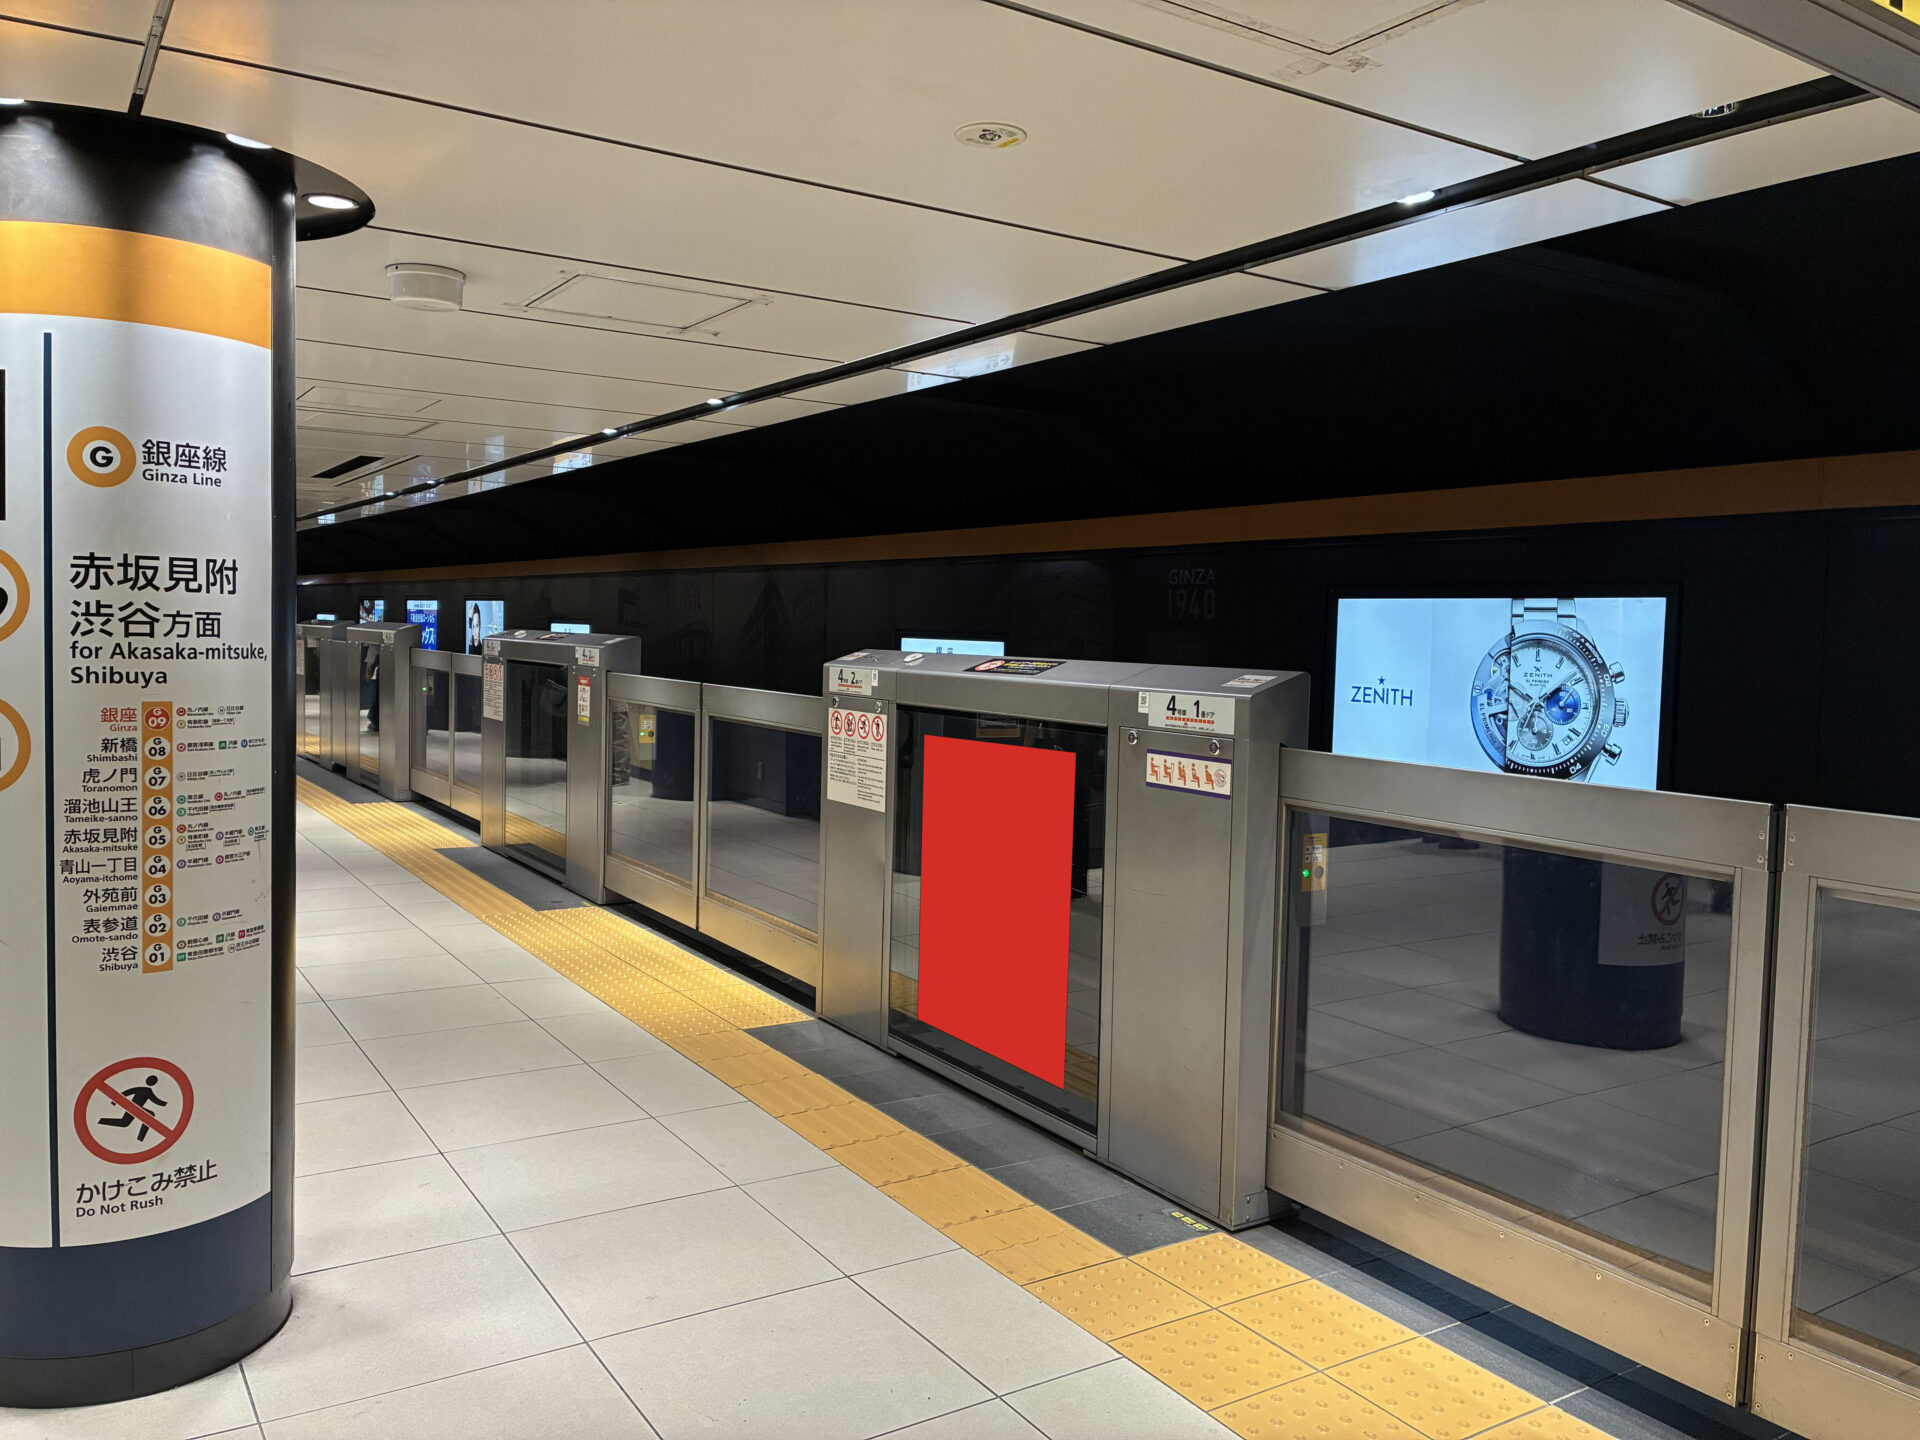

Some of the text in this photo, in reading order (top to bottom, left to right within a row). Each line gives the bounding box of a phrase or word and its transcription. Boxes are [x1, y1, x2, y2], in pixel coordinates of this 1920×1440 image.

[89, 446, 114, 468] G
[142, 438, 227, 473] 銀座線
[142, 469, 222, 487] Ginza Line
[69, 552, 238, 595] 赤坂見附
[1168, 568, 1216, 584] GINZA
[1168, 588, 1216, 620] 1940
[70, 600, 222, 638] 渋谷方面
[70, 641, 268, 662] for Akasaka-mitsuke,
[71, 666, 167, 688] Shibuya
[1351, 686, 1413, 706] ZENITH
[100, 707, 138, 723] 銀座
[148, 717, 166, 727] 09
[109, 724, 137, 732] Ginza
[101, 737, 138, 753] 新橋
[148, 747, 166, 757] 08
[87, 754, 138, 762] Shimbashi
[82, 768, 137, 783] 虎ノ門
[148, 776, 166, 786] 07
[64, 797, 137, 814] 溜池山王
[148, 806, 166, 816] 06
[64, 827, 137, 844] 赤坂見附
[148, 835, 166, 846] 05
[63, 844, 138, 853] Akasaka-mitsuke
[59, 857, 137, 874] 青山一丁目
[148, 865, 166, 875] 04
[63, 875, 138, 885] Aoyama-itchome
[83, 887, 138, 904] 外苑前
[149, 894, 166, 904] 03
[86, 904, 138, 912] Gaiemmae
[83, 916, 138, 934] 表参道
[149, 923, 166, 934] 02
[72, 933, 138, 943] Omote-sando
[102, 945, 138, 962] 渋谷
[149, 953, 165, 963] 01
[99, 962, 138, 972] Shibuya
[76, 1160, 218, 1204] かけこみ禁止
[76, 1196, 163, 1218] Do Not Rush
